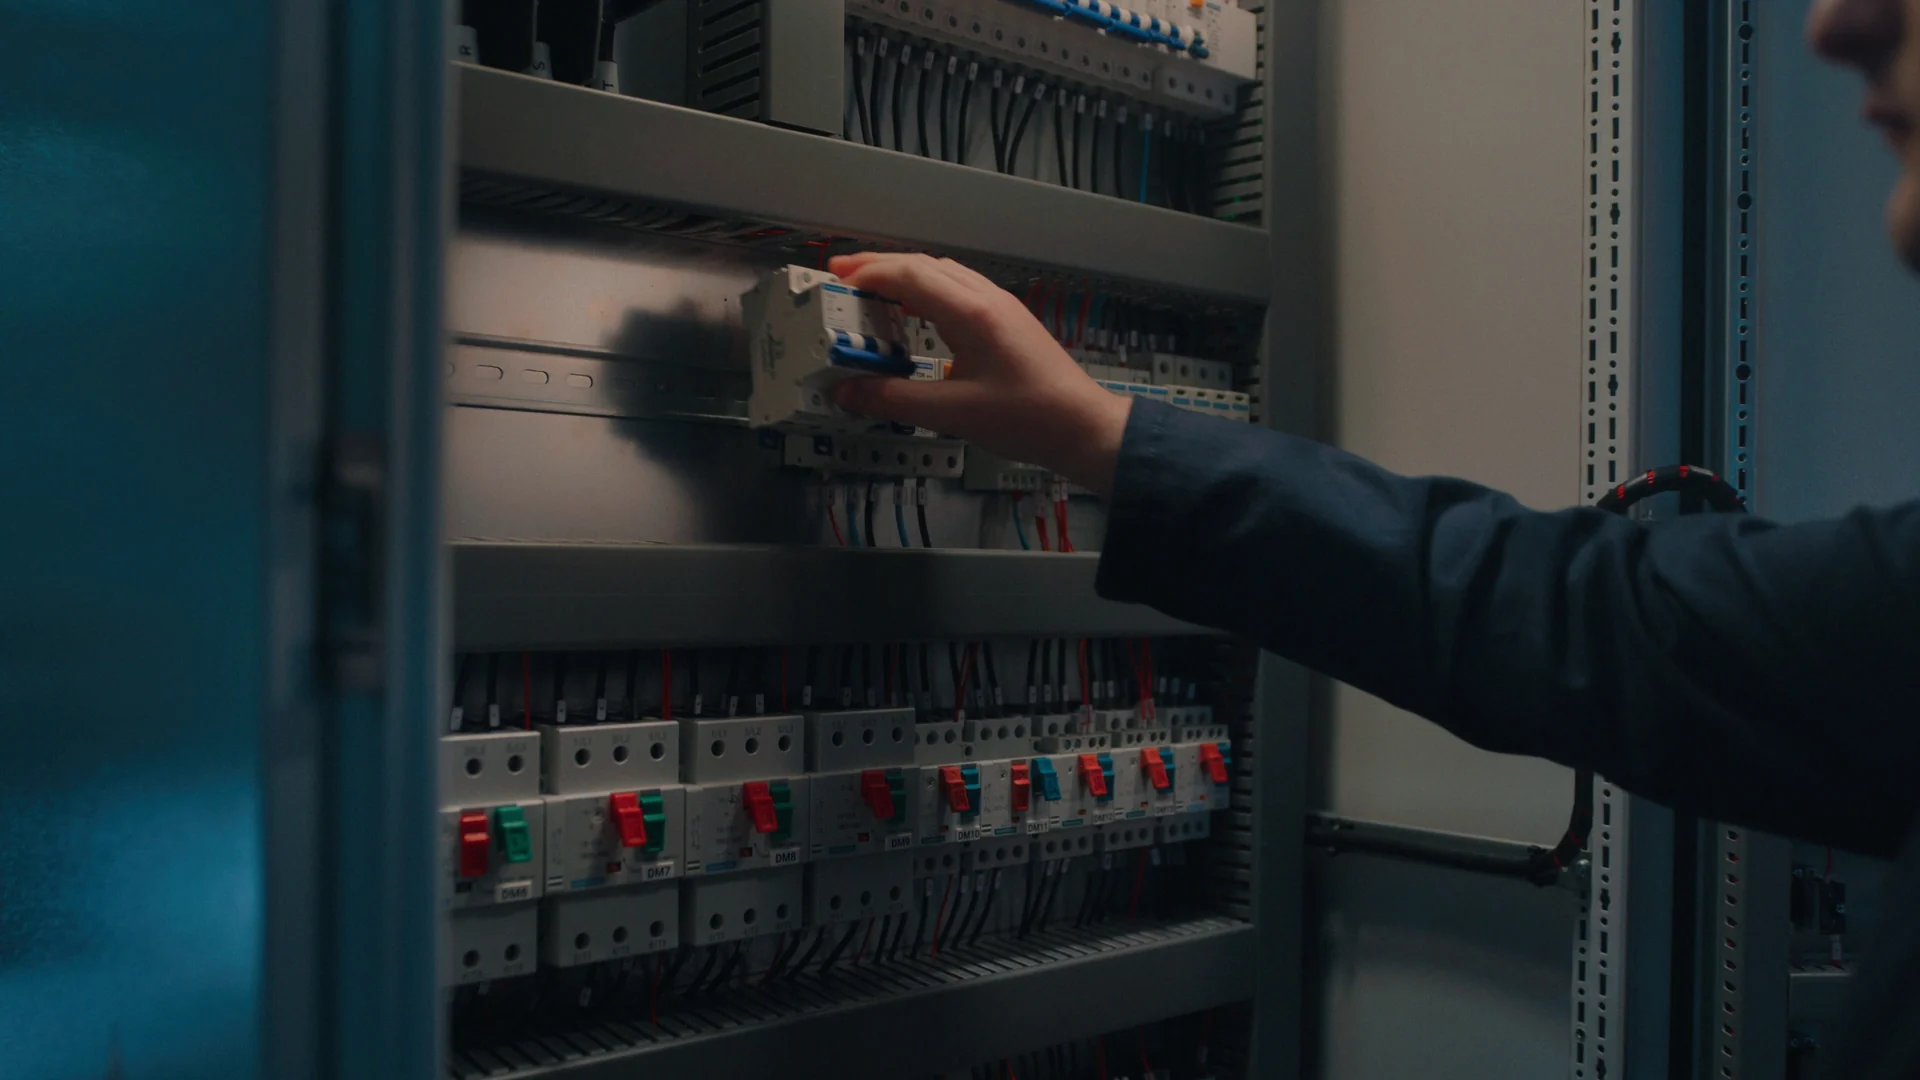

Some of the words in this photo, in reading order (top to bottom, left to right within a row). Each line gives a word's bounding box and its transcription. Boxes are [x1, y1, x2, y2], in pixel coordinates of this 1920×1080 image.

[459, 45, 472, 56] R
[533, 61, 545, 70] S
[602, 80, 614, 90] T
[958, 830, 980, 841] DM10
[775, 851, 796, 863] DM8
[647, 866, 671, 879] DM7
